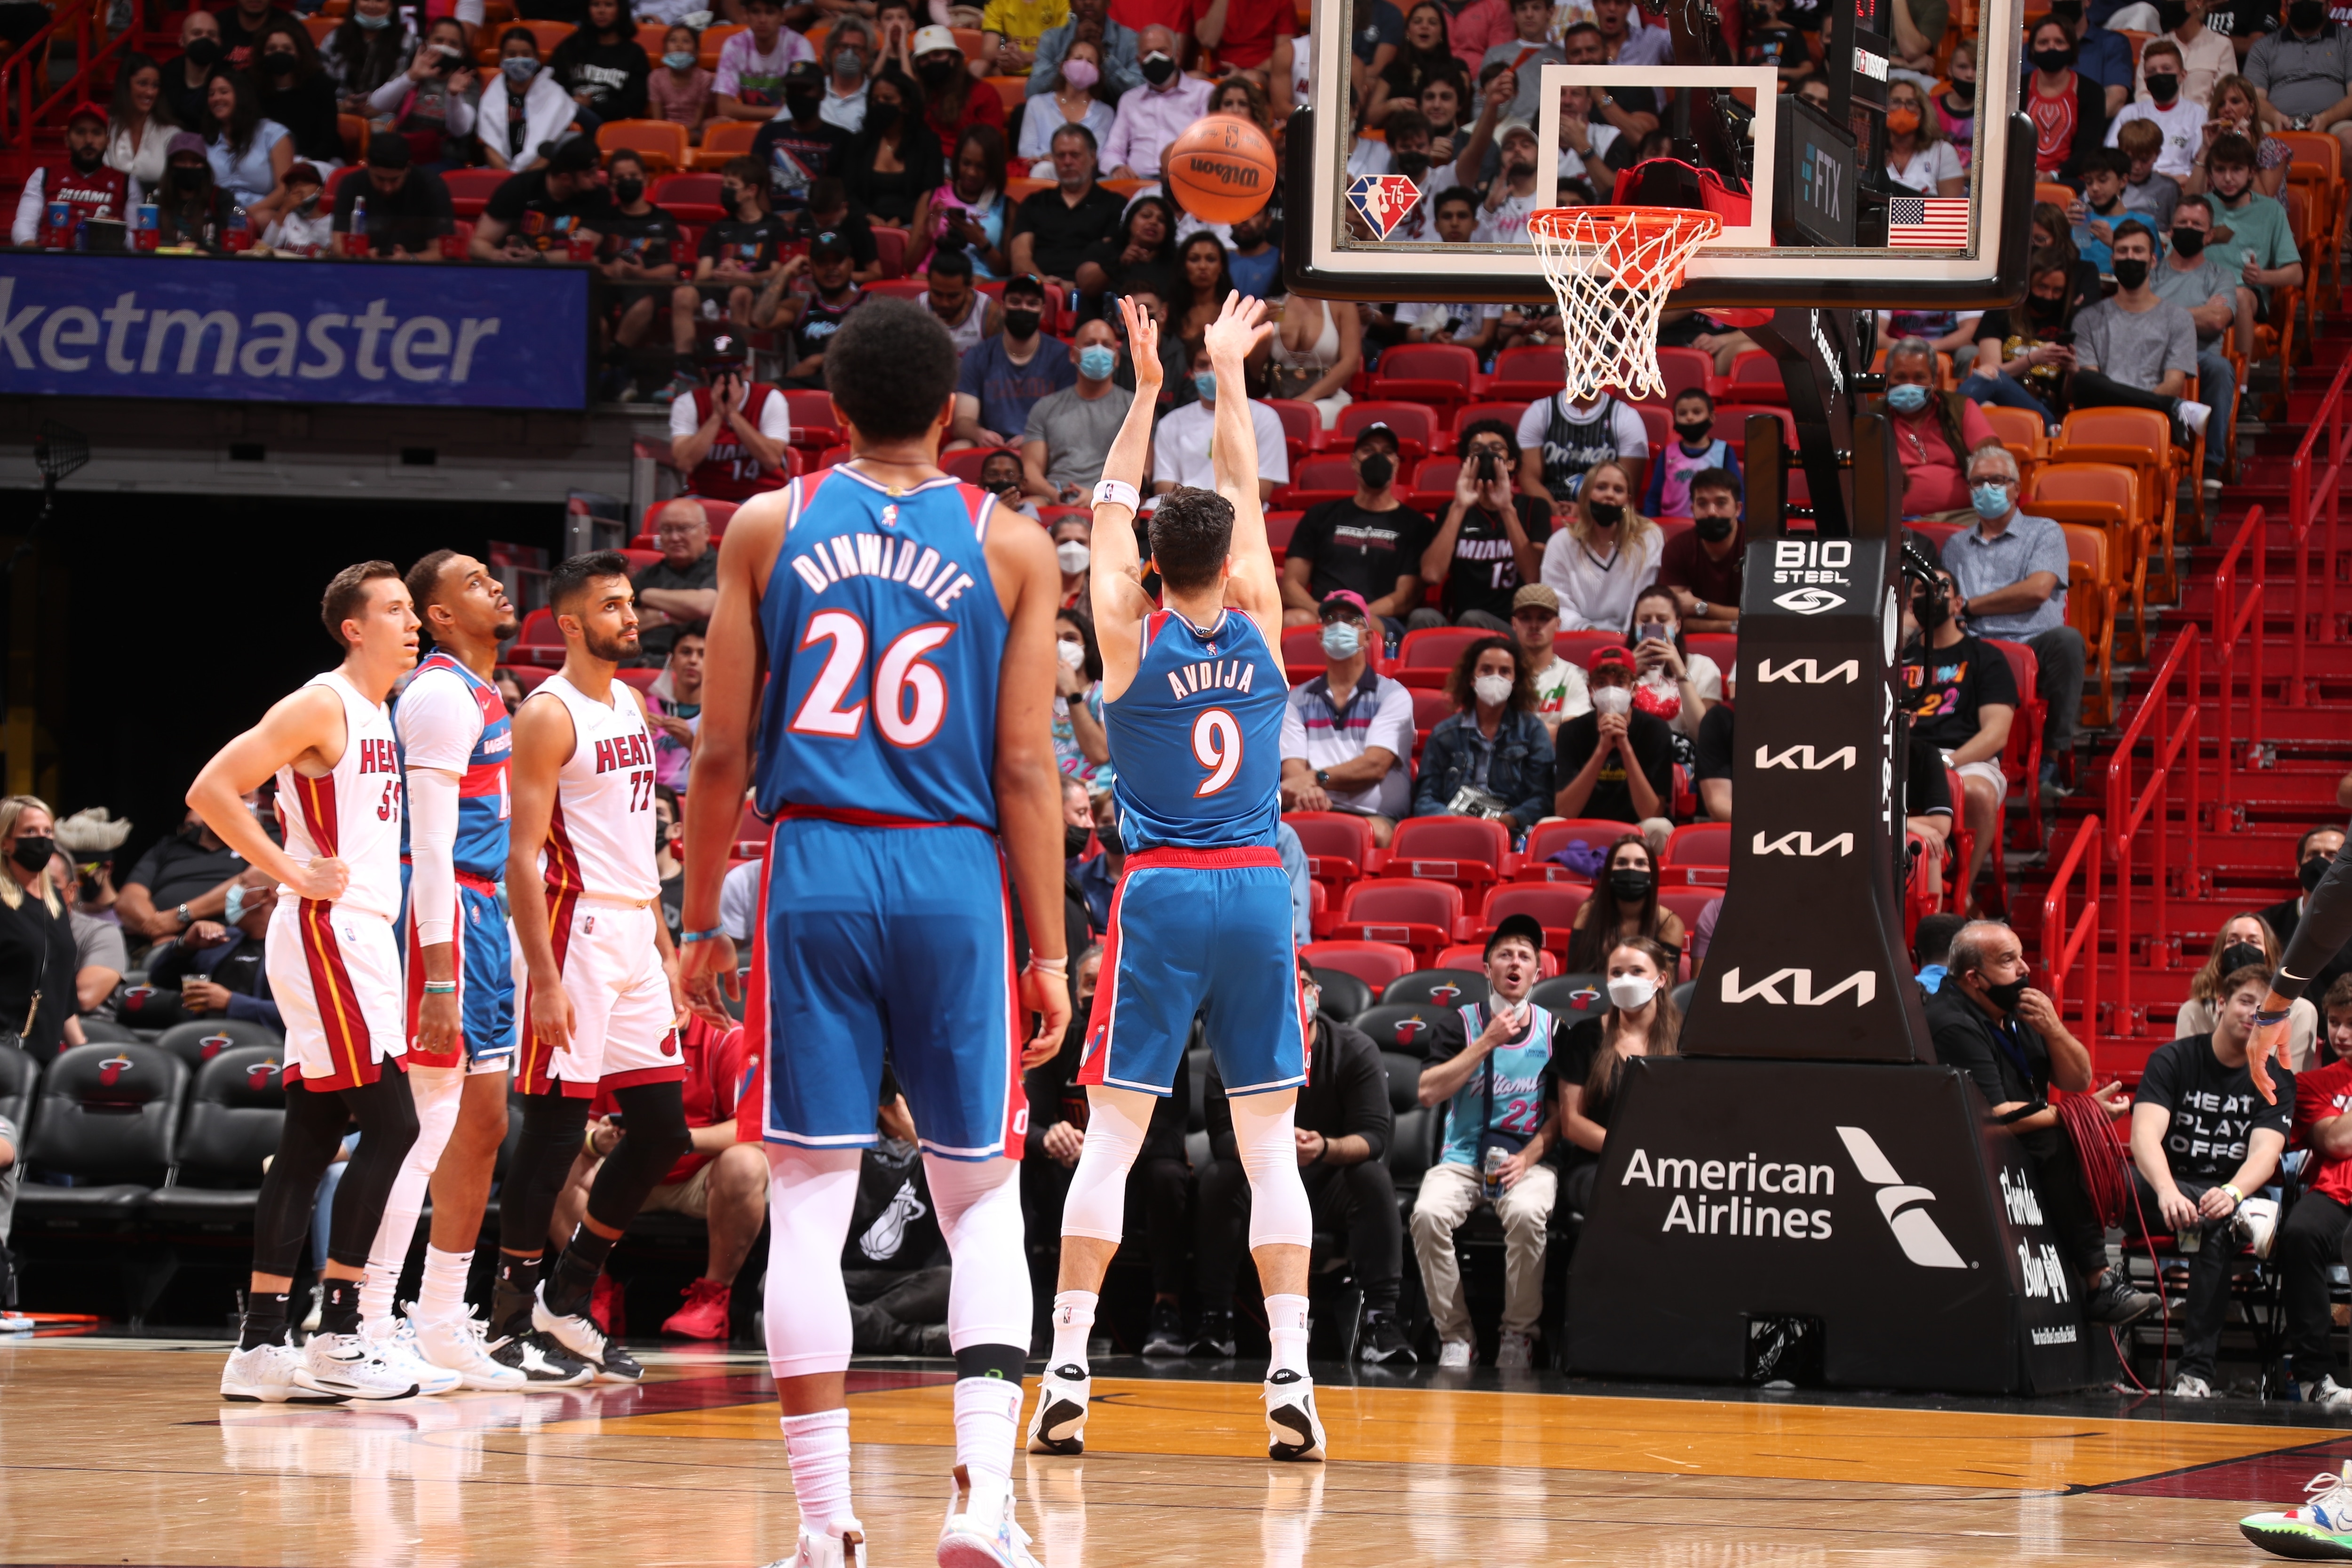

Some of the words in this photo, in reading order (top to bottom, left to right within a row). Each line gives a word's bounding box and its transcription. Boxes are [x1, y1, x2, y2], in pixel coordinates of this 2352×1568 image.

[1190, 157, 1259, 187] Wilson
[1815, 148, 1841, 222] FTX
[57, 188, 113, 203] MIAMI
[1391, 185, 1404, 204] 75
[0, 277, 500, 383] ketmaster
[732, 458, 761, 482] 14
[1456, 539, 1516, 560] MIAM
[1775, 541, 1852, 568] BIO
[791, 533, 975, 611] DINWIDDIE
[1773, 570, 1849, 583] STEEL
[785, 607, 959, 750] 26
[1167, 660, 1255, 701] AVDIJA
[1917, 687, 1961, 716] 22
[595, 723, 652, 774] HEAT
[1190, 706, 1243, 798] 9
[1883, 680, 1893, 836] AT&T
[630, 770, 654, 813] 77
[1499, 1098, 1544, 1135] 22
[2182, 1090, 2255, 1114] HEAT
[2175, 1111, 2251, 1138] PLAY
[2169, 1134, 2247, 1161] OFFS
[1621, 1149, 1835, 1195] American
[1999, 1165, 2043, 1226] Florida
[1662, 1195, 1833, 1240] Airlines
[2018, 1236, 2049, 1297] Blue
